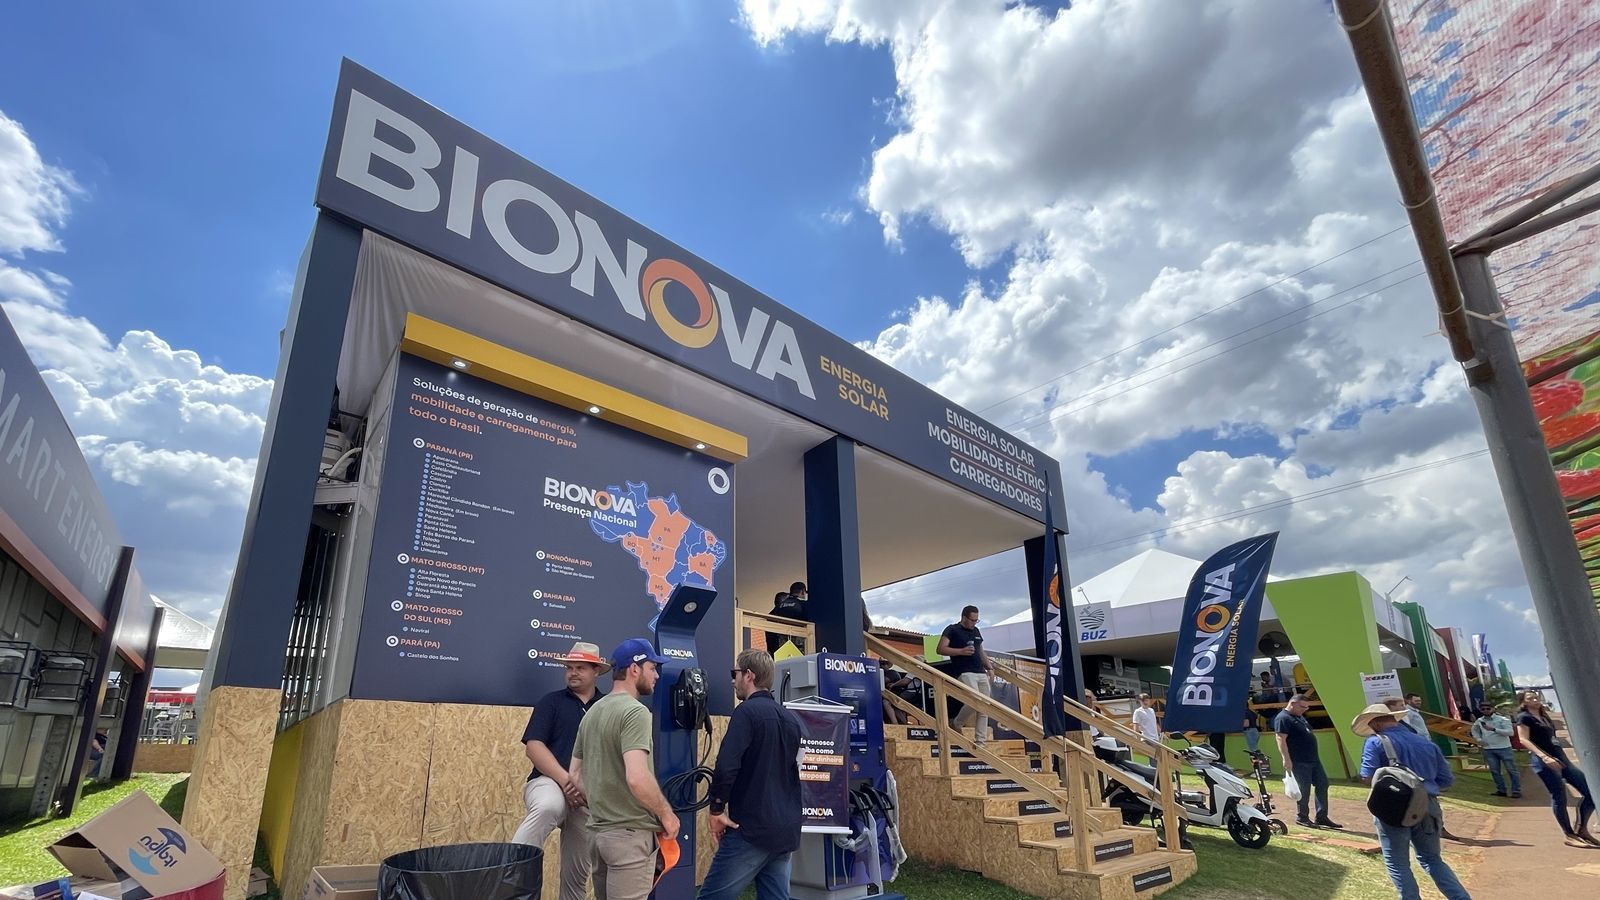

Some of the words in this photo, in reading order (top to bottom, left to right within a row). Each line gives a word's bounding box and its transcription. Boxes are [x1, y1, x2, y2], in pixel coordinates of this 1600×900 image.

[334, 88, 816, 400] BIONOVA
[820, 355, 888, 404] ENERGIA
[408, 406, 437, 422] todo
[439, 416, 447, 424] o
[450, 418, 483, 435] Brasil.
[410, 392, 476, 418] mobilidade
[478, 412, 484, 421] e
[486, 415, 556, 442] carregamento
[556, 437, 578, 449] para
[412, 377, 466, 400] Soluções
[467, 395, 481, 406] de
[482, 400, 524, 418] geração
[526, 413, 538, 424] de
[540, 419, 577, 436] energia,
[838, 384, 890, 422] SOLAR
[426, 442, 458, 456] PARANÁ
[458, 451, 474, 460] (PR)
[946, 407, 999, 448] ENERGIA
[1000, 437, 1035, 468] SOLAR
[927, 421, 1004, 473] MOBILIDADE
[1005, 462, 1052, 496] ELÉTRIC
[544, 476, 637, 517] BIONOVA
[950, 458, 1042, 512] CARREGADORES
[543, 498, 592, 518] Presença
[593, 510, 637, 528] Nacional
[57, 484, 118, 592] ENERGY
[410, 556, 434, 566] MATO
[435, 560, 468, 571] GROSSO
[468, 566, 485, 575] (MT)
[546, 554, 580, 564] RONDÔNIA
[404, 604, 429, 612] MATO
[430, 606, 463, 616] GROSSO
[434, 617, 452, 626] (MS)
[400, 638, 422, 647] PARÁ
[424, 640, 440, 649] (PA)
[664, 648, 694, 658] BIONOVA
[1081, 630, 1108, 641] BUZ
[1182, 562, 1236, 708] BIONOVA
[1226, 628, 1238, 668] ENERGIA
[824, 658, 866, 674] BIONOVA
